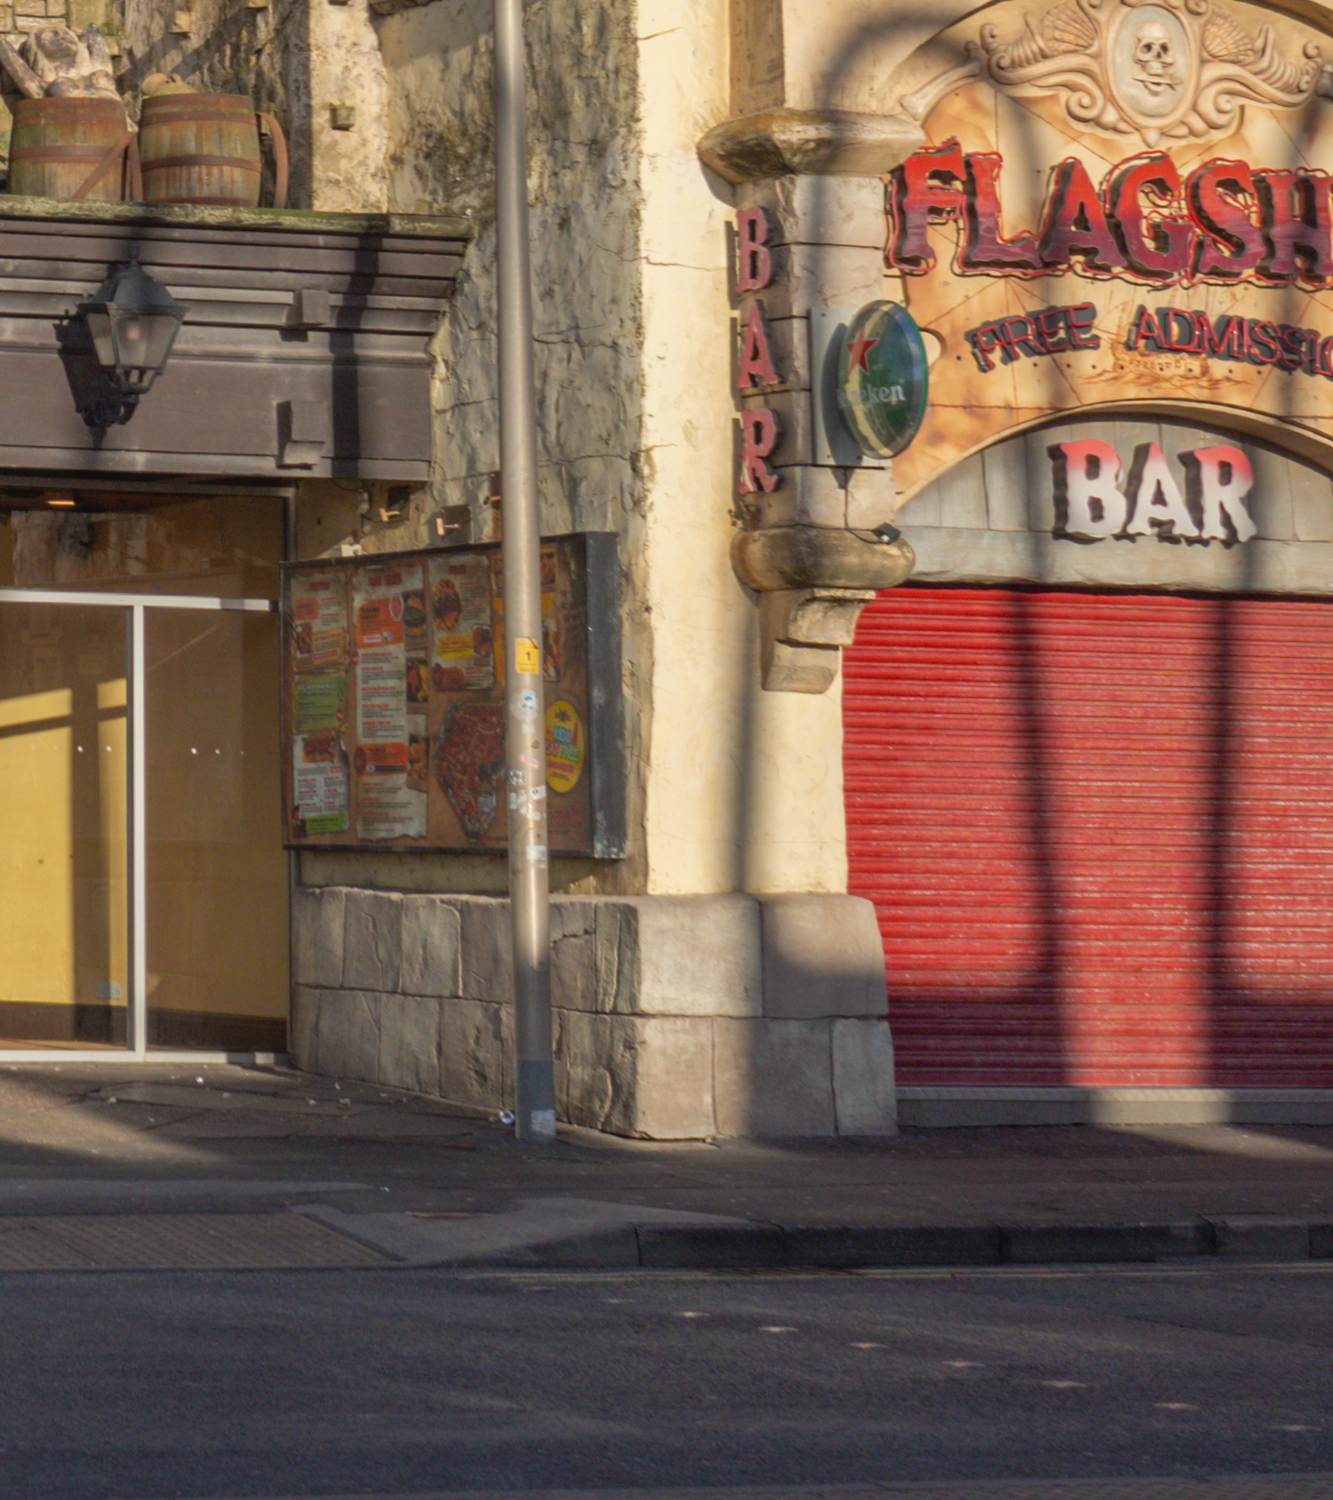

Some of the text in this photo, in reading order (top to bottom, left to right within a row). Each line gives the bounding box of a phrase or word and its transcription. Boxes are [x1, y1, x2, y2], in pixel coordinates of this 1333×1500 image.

[889, 141, 1333, 284] FLAGSH
[735, 206, 783, 495] BAR
[973, 303, 1100, 373] FREE
[1055, 437, 1259, 541] BAR
[558, 742, 581, 764] FREE
